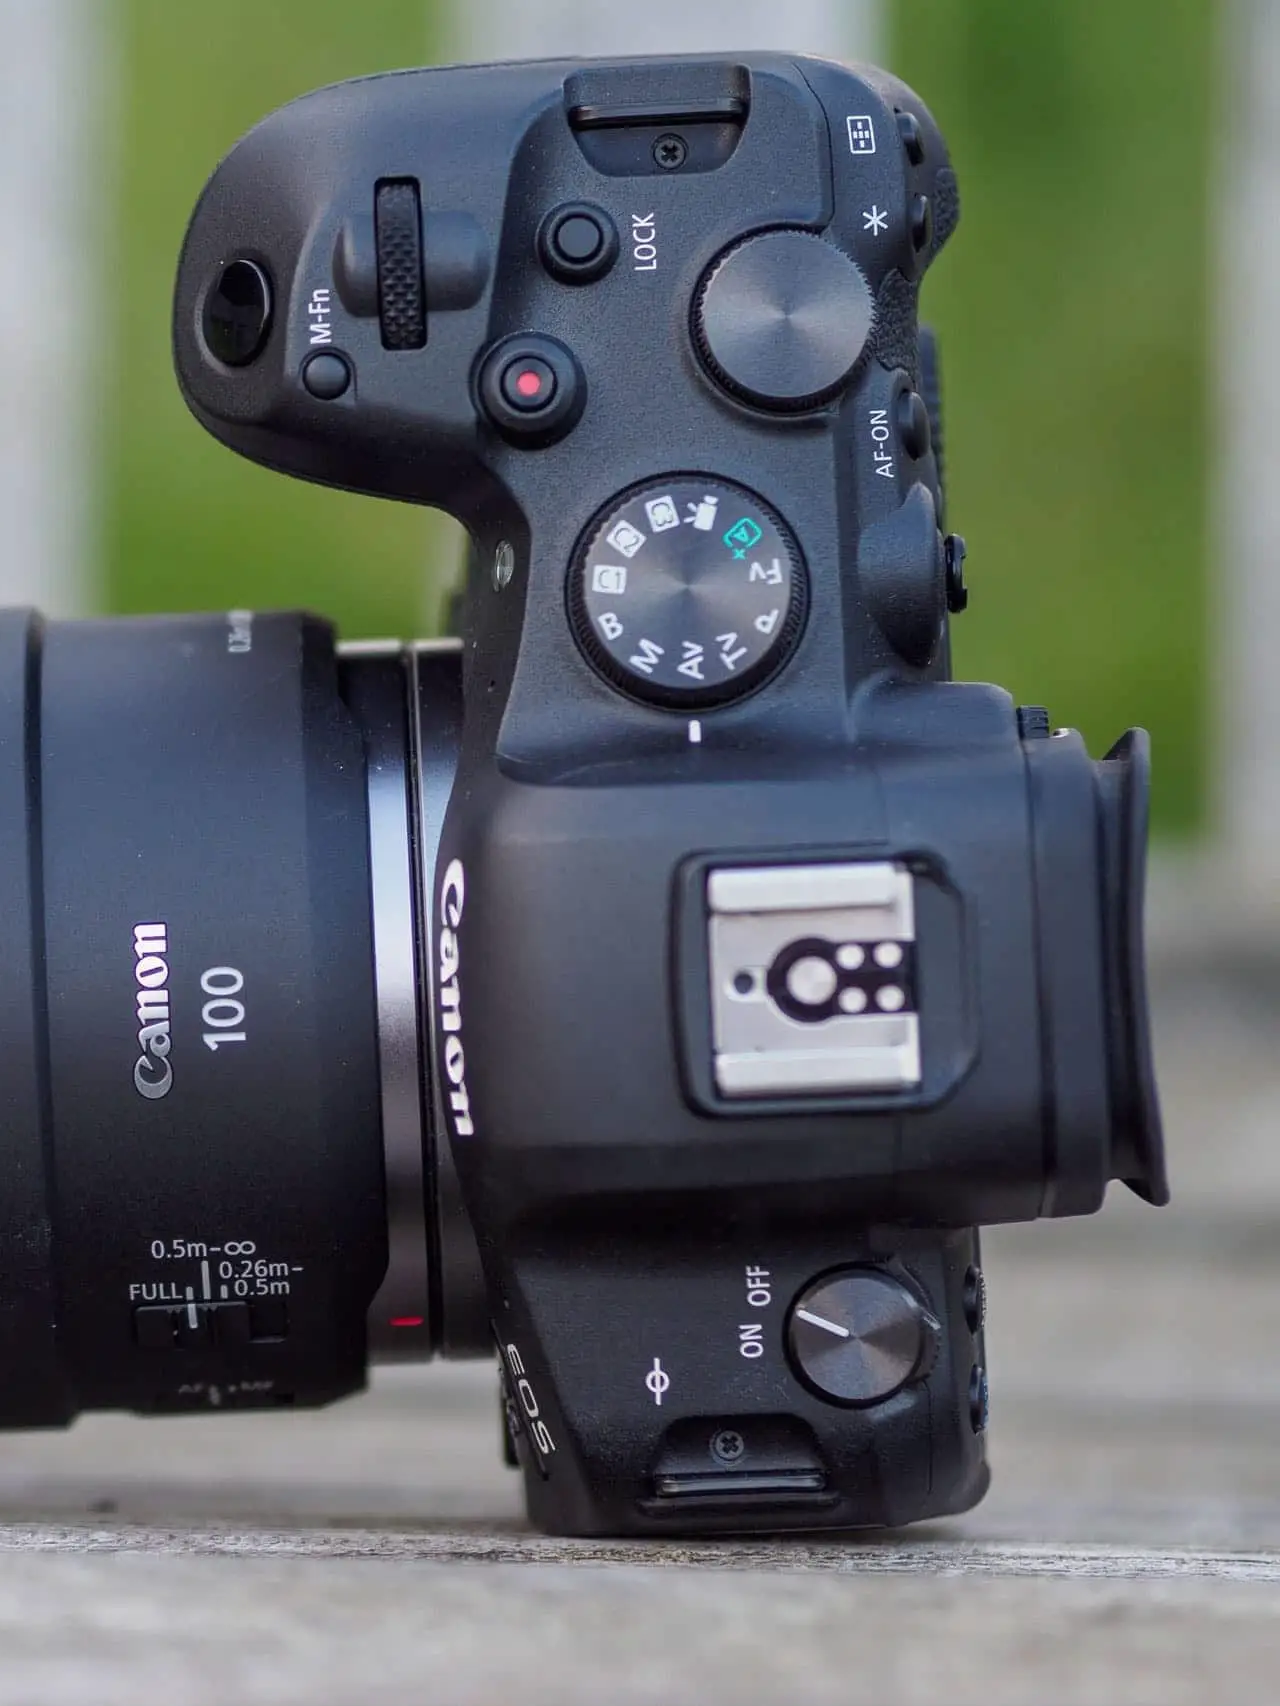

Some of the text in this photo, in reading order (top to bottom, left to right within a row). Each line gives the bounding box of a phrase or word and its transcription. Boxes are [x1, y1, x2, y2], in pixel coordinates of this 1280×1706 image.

[632, 212, 656, 271] LOCK
[308, 289, 332, 345] M-Fn
[869, 409, 895, 478] AF-ON
[610, 523, 643, 554] C2
[595, 567, 624, 592] C1
[598, 612, 624, 640] B
[754, 609, 779, 634] P
[629, 638, 665, 673] M
[134, 923, 173, 1099] Canon
[200, 966, 246, 1051] 100
[440, 858, 474, 1135] Canon
[129, 1282, 183, 1300] FULL
[234, 1279, 290, 1296] 0.5m
[745, 1266, 771, 1307] OFF
[738, 1324, 764, 1358] ON
[507, 1344, 555, 1454] EOS
